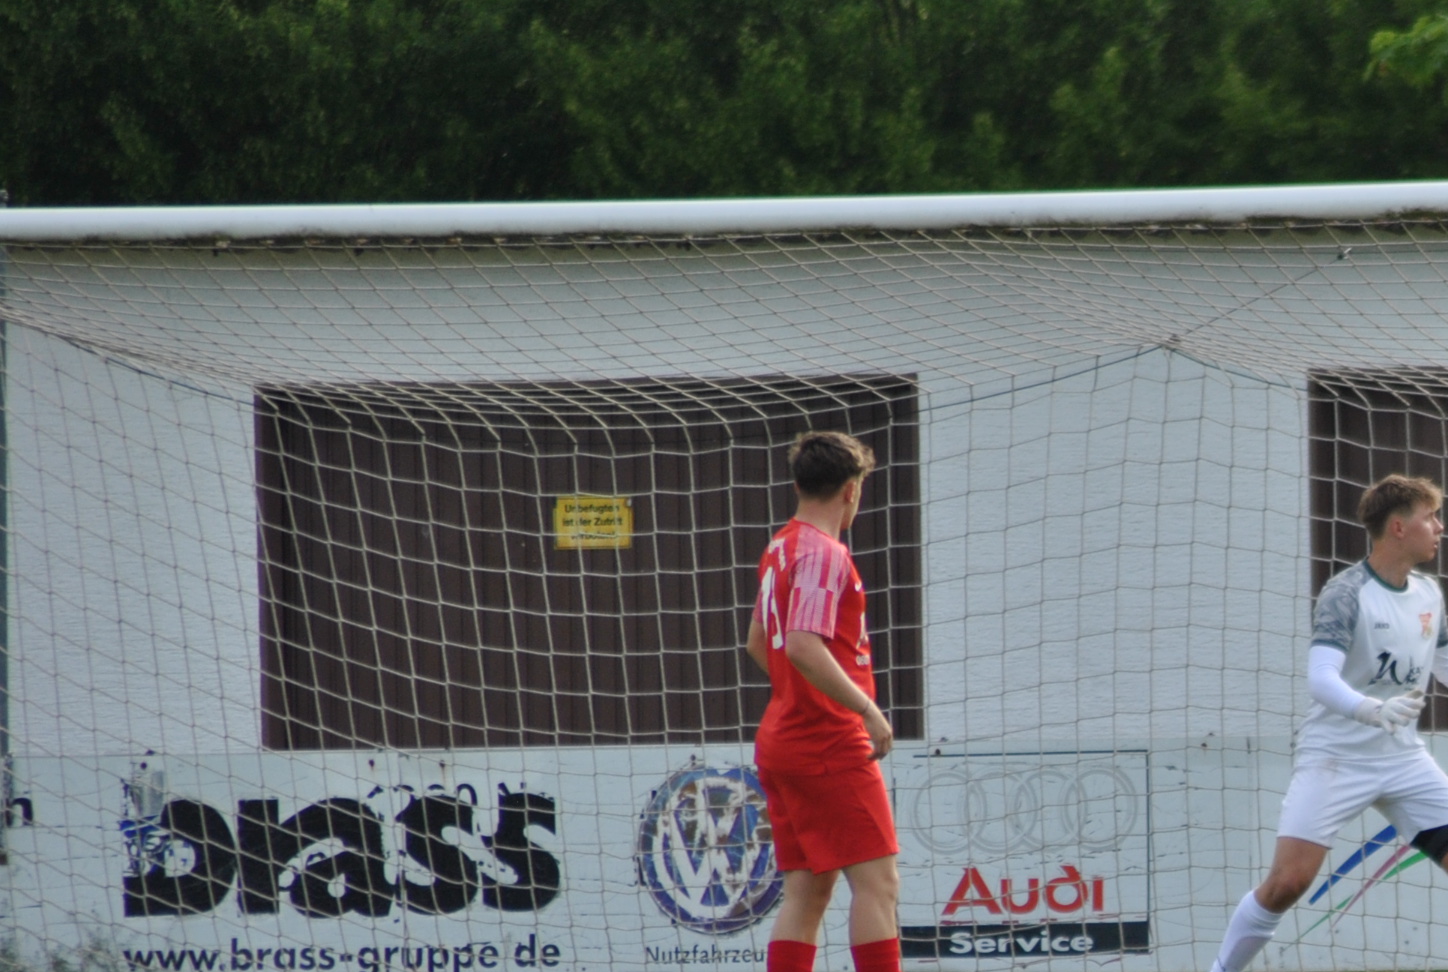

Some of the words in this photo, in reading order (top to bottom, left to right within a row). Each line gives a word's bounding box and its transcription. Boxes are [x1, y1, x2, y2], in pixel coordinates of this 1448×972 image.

[941, 864, 1104, 915] Audi
[645, 943, 766, 965] Nutzfahrzeu
[950, 931, 1094, 954] Service
